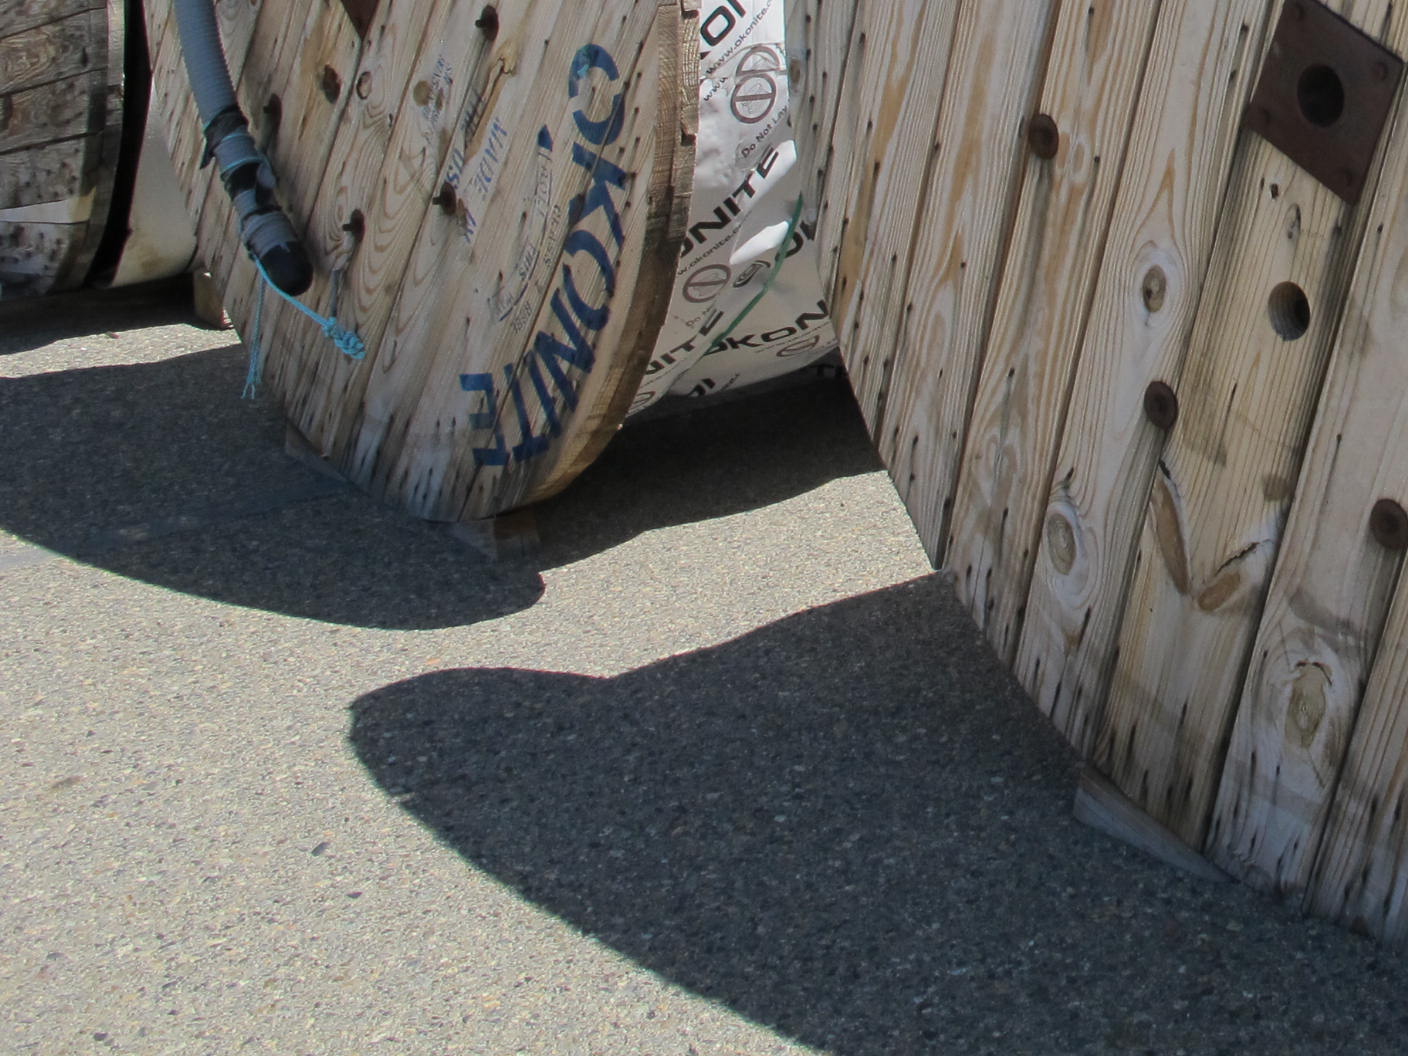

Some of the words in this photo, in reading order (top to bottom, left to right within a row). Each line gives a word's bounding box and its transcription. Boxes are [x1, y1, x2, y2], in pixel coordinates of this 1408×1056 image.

[459, 44, 627, 466] OKONITE
[741, 143, 756, 159] Do
[756, 124, 773, 142] Not
